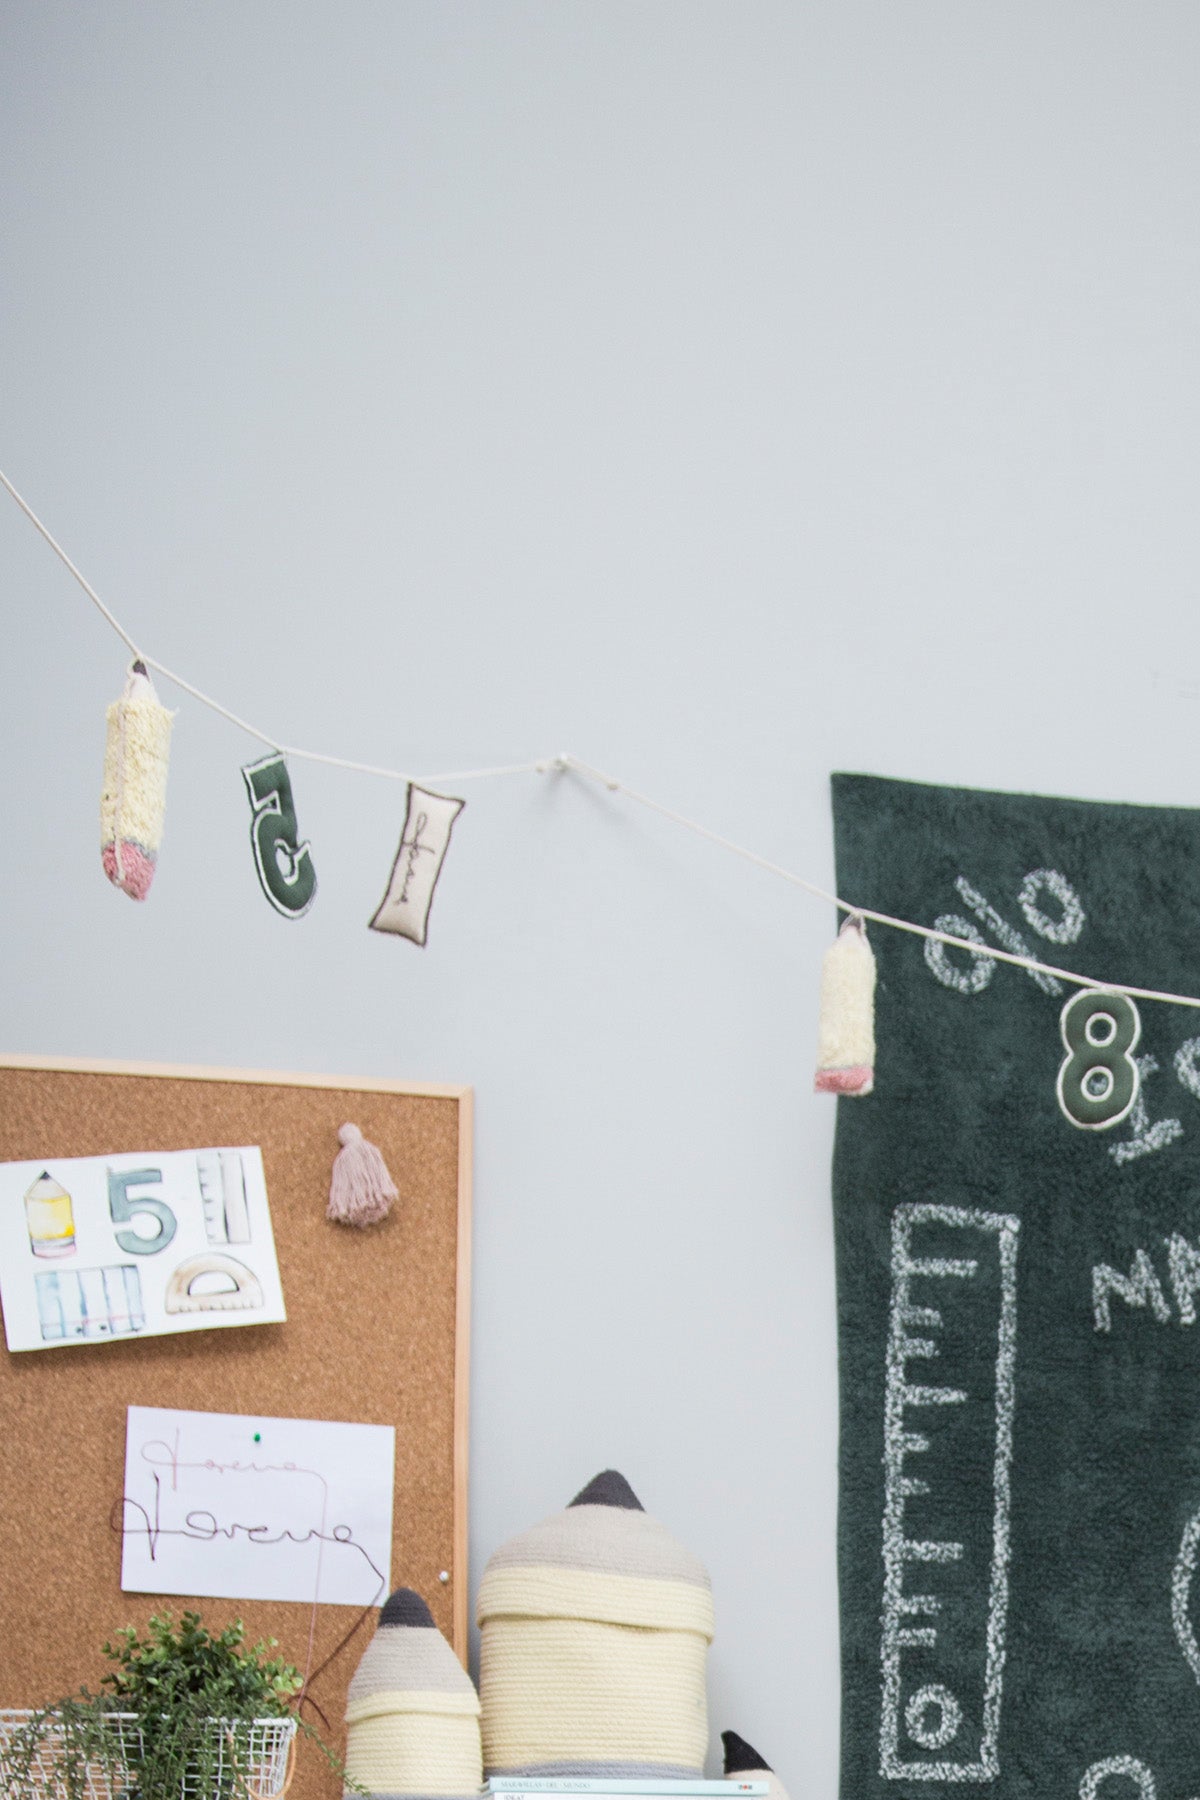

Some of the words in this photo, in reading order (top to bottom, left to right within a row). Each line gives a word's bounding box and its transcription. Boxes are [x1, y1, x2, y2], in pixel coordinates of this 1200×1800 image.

[239, 750, 318, 921] 5
[1056, 986, 1141, 1130] 8
[107, 1165, 178, 1256] 5
